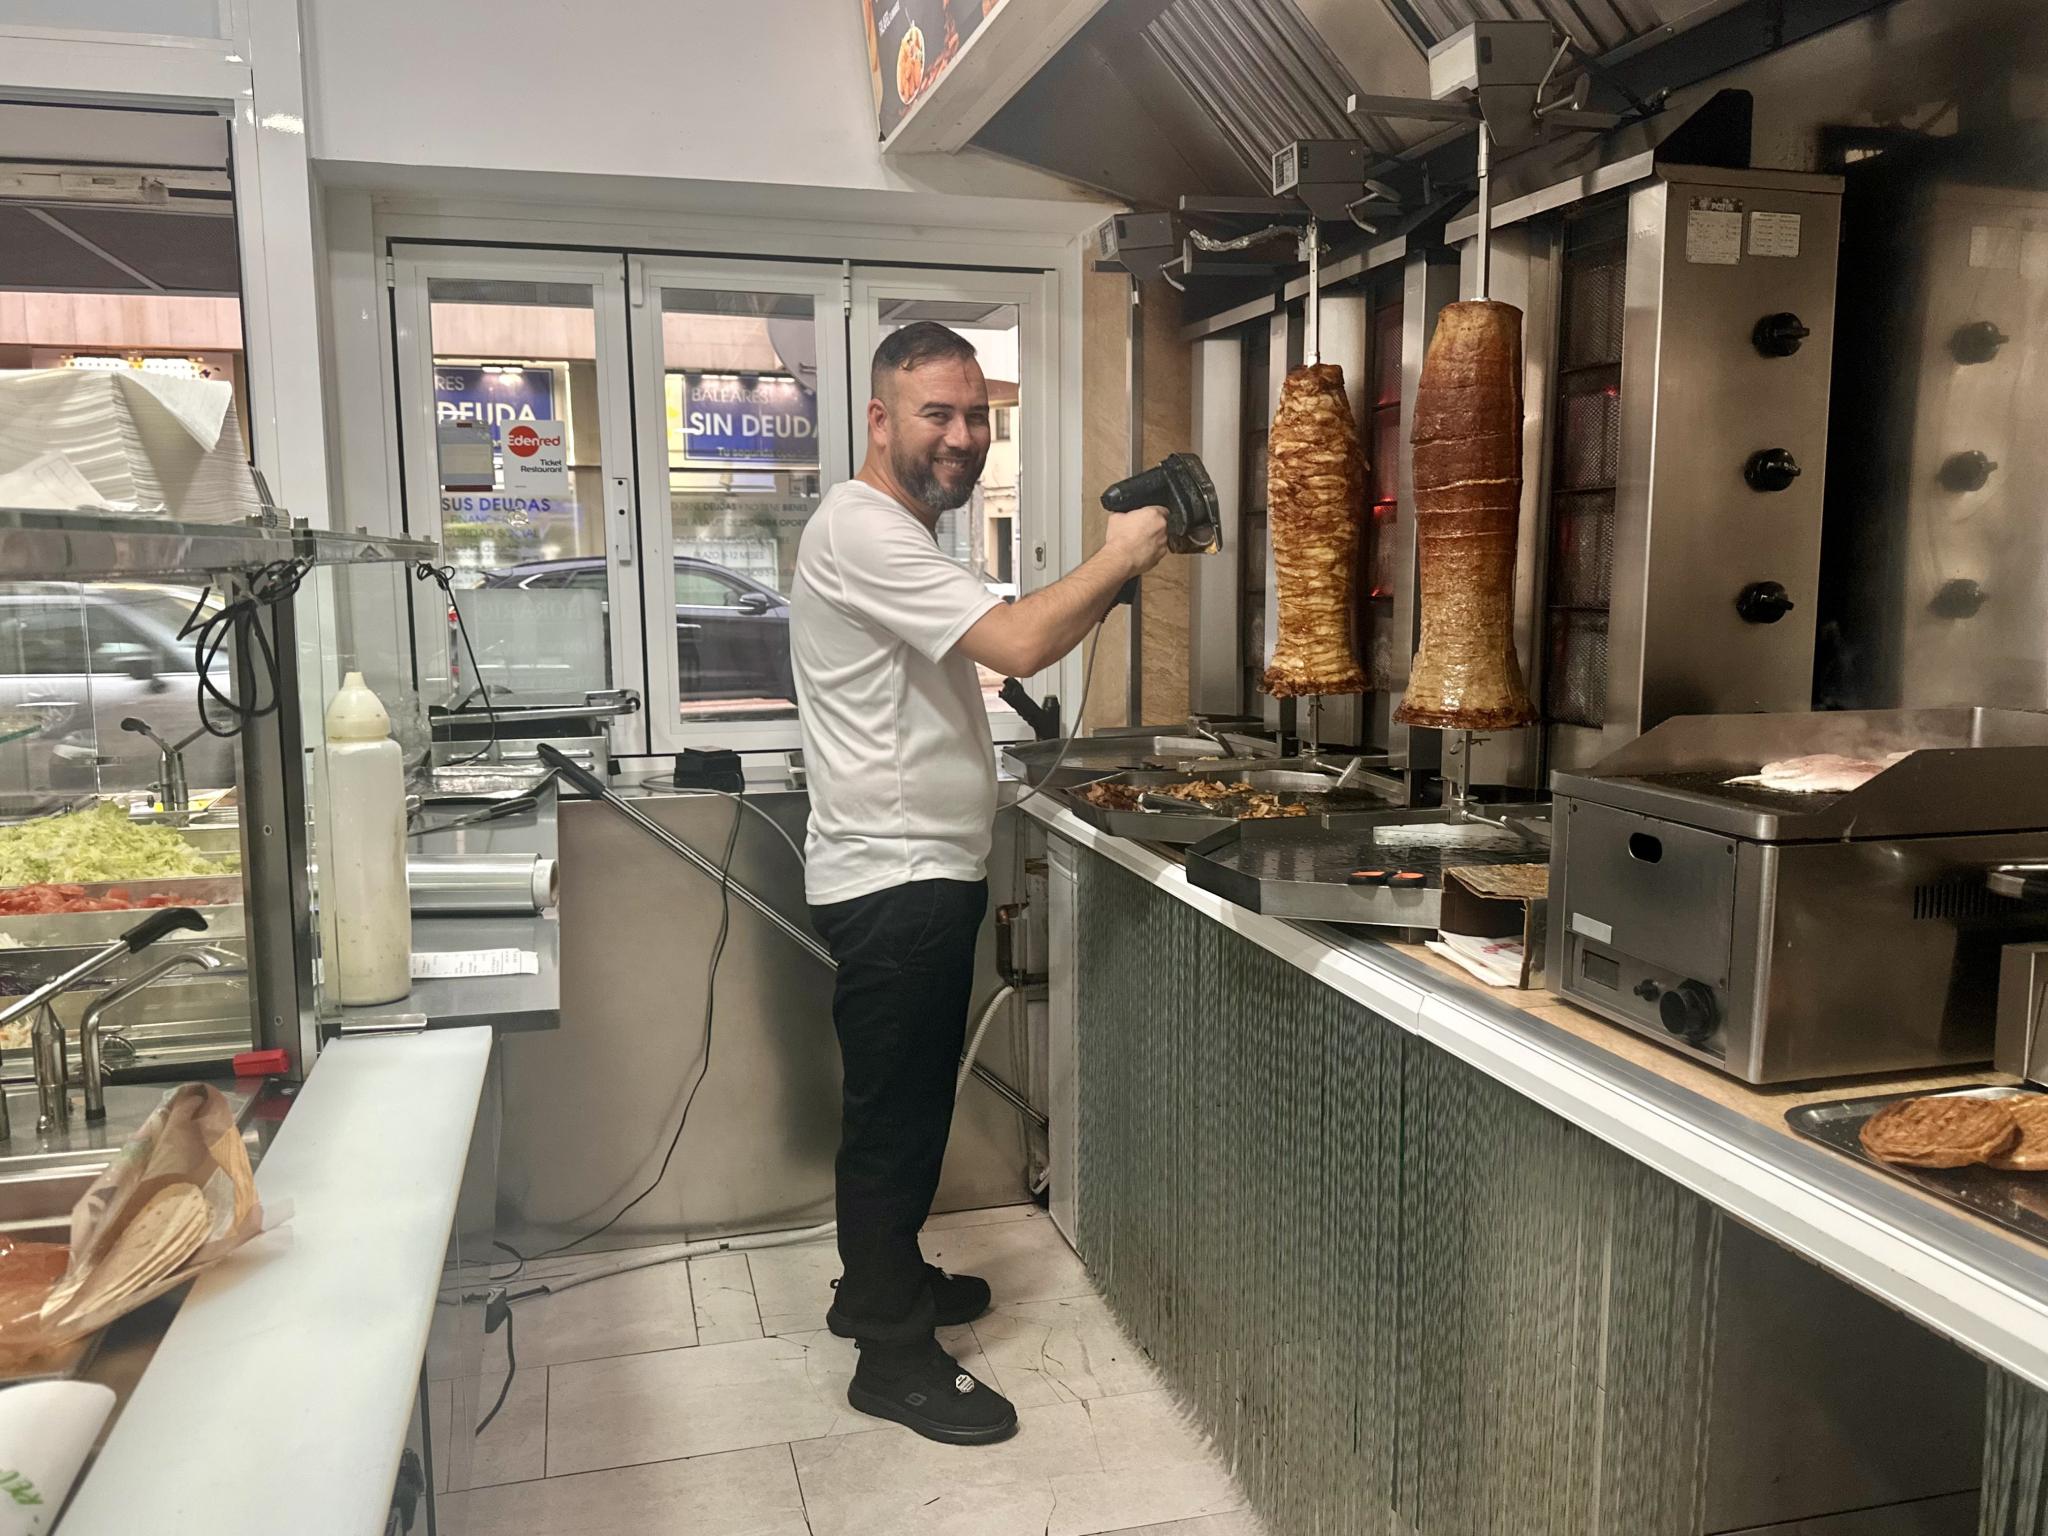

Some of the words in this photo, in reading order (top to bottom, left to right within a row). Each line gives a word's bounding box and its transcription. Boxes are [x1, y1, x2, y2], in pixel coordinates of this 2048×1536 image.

[691, 387, 769, 405] BALEARES
[690, 411, 733, 437] SIN
[507, 435, 560, 447] Edenred
[520, 465, 562, 473] Restaurant
[441, 497, 473, 511] SUS
[479, 498, 551, 512] DEUDAS
